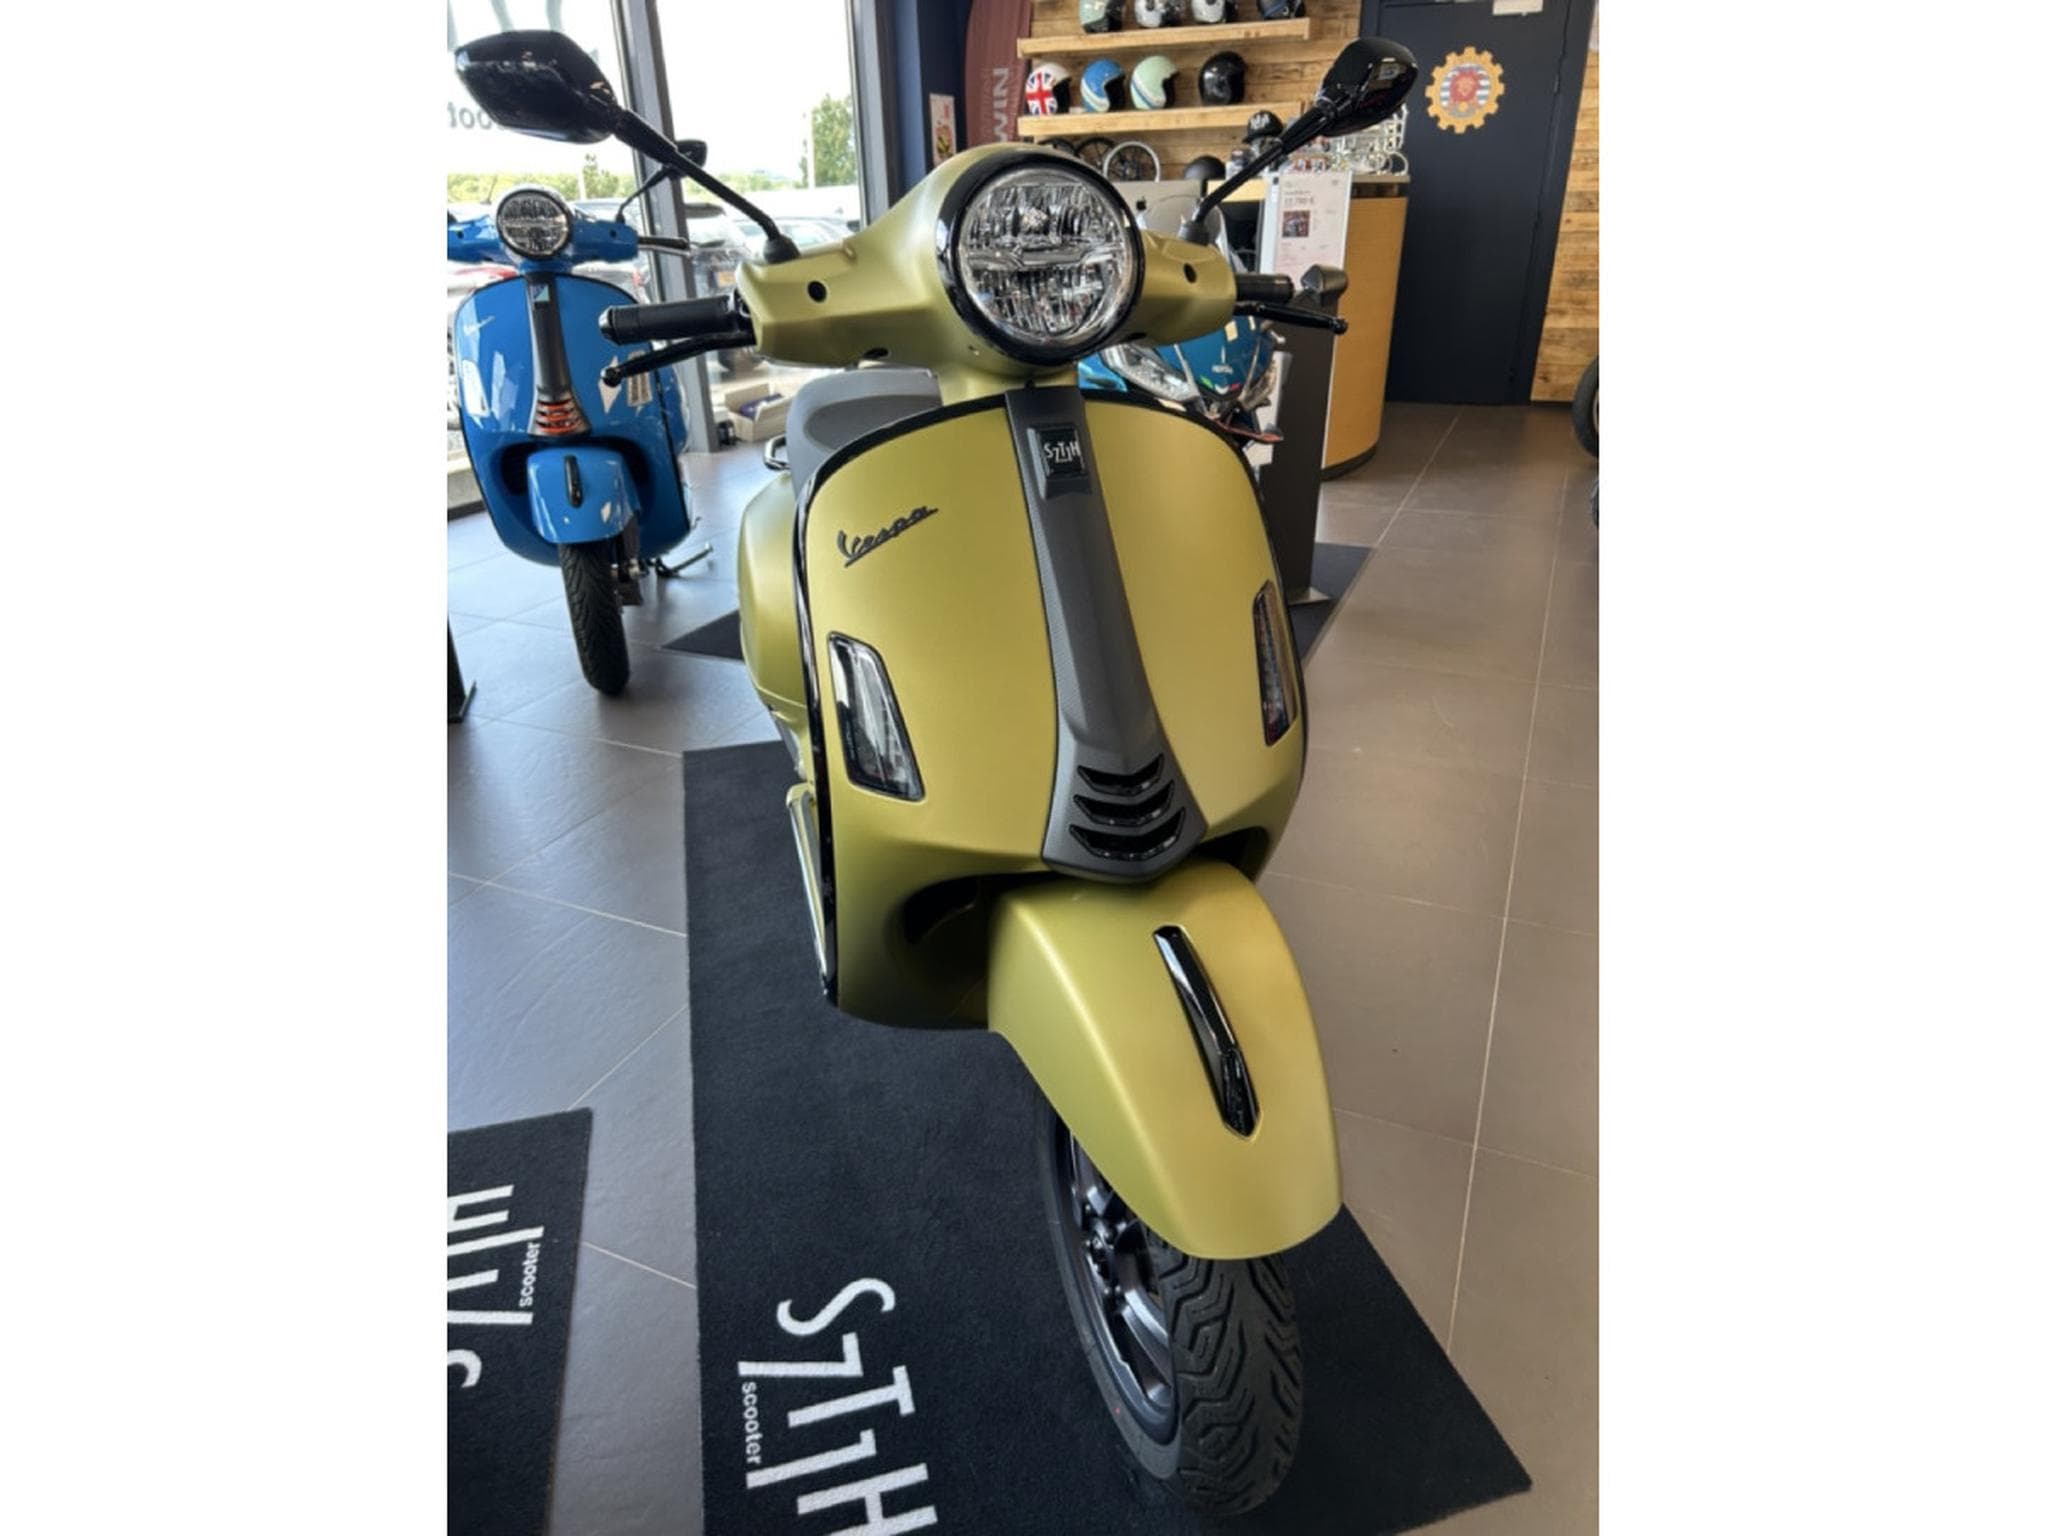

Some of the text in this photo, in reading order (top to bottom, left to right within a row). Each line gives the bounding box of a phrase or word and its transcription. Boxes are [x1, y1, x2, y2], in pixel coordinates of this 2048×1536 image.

[837, 506, 939, 568] Vespa
[519, 1241, 541, 1308] scooter
[742, 1381, 763, 1465] scooter
